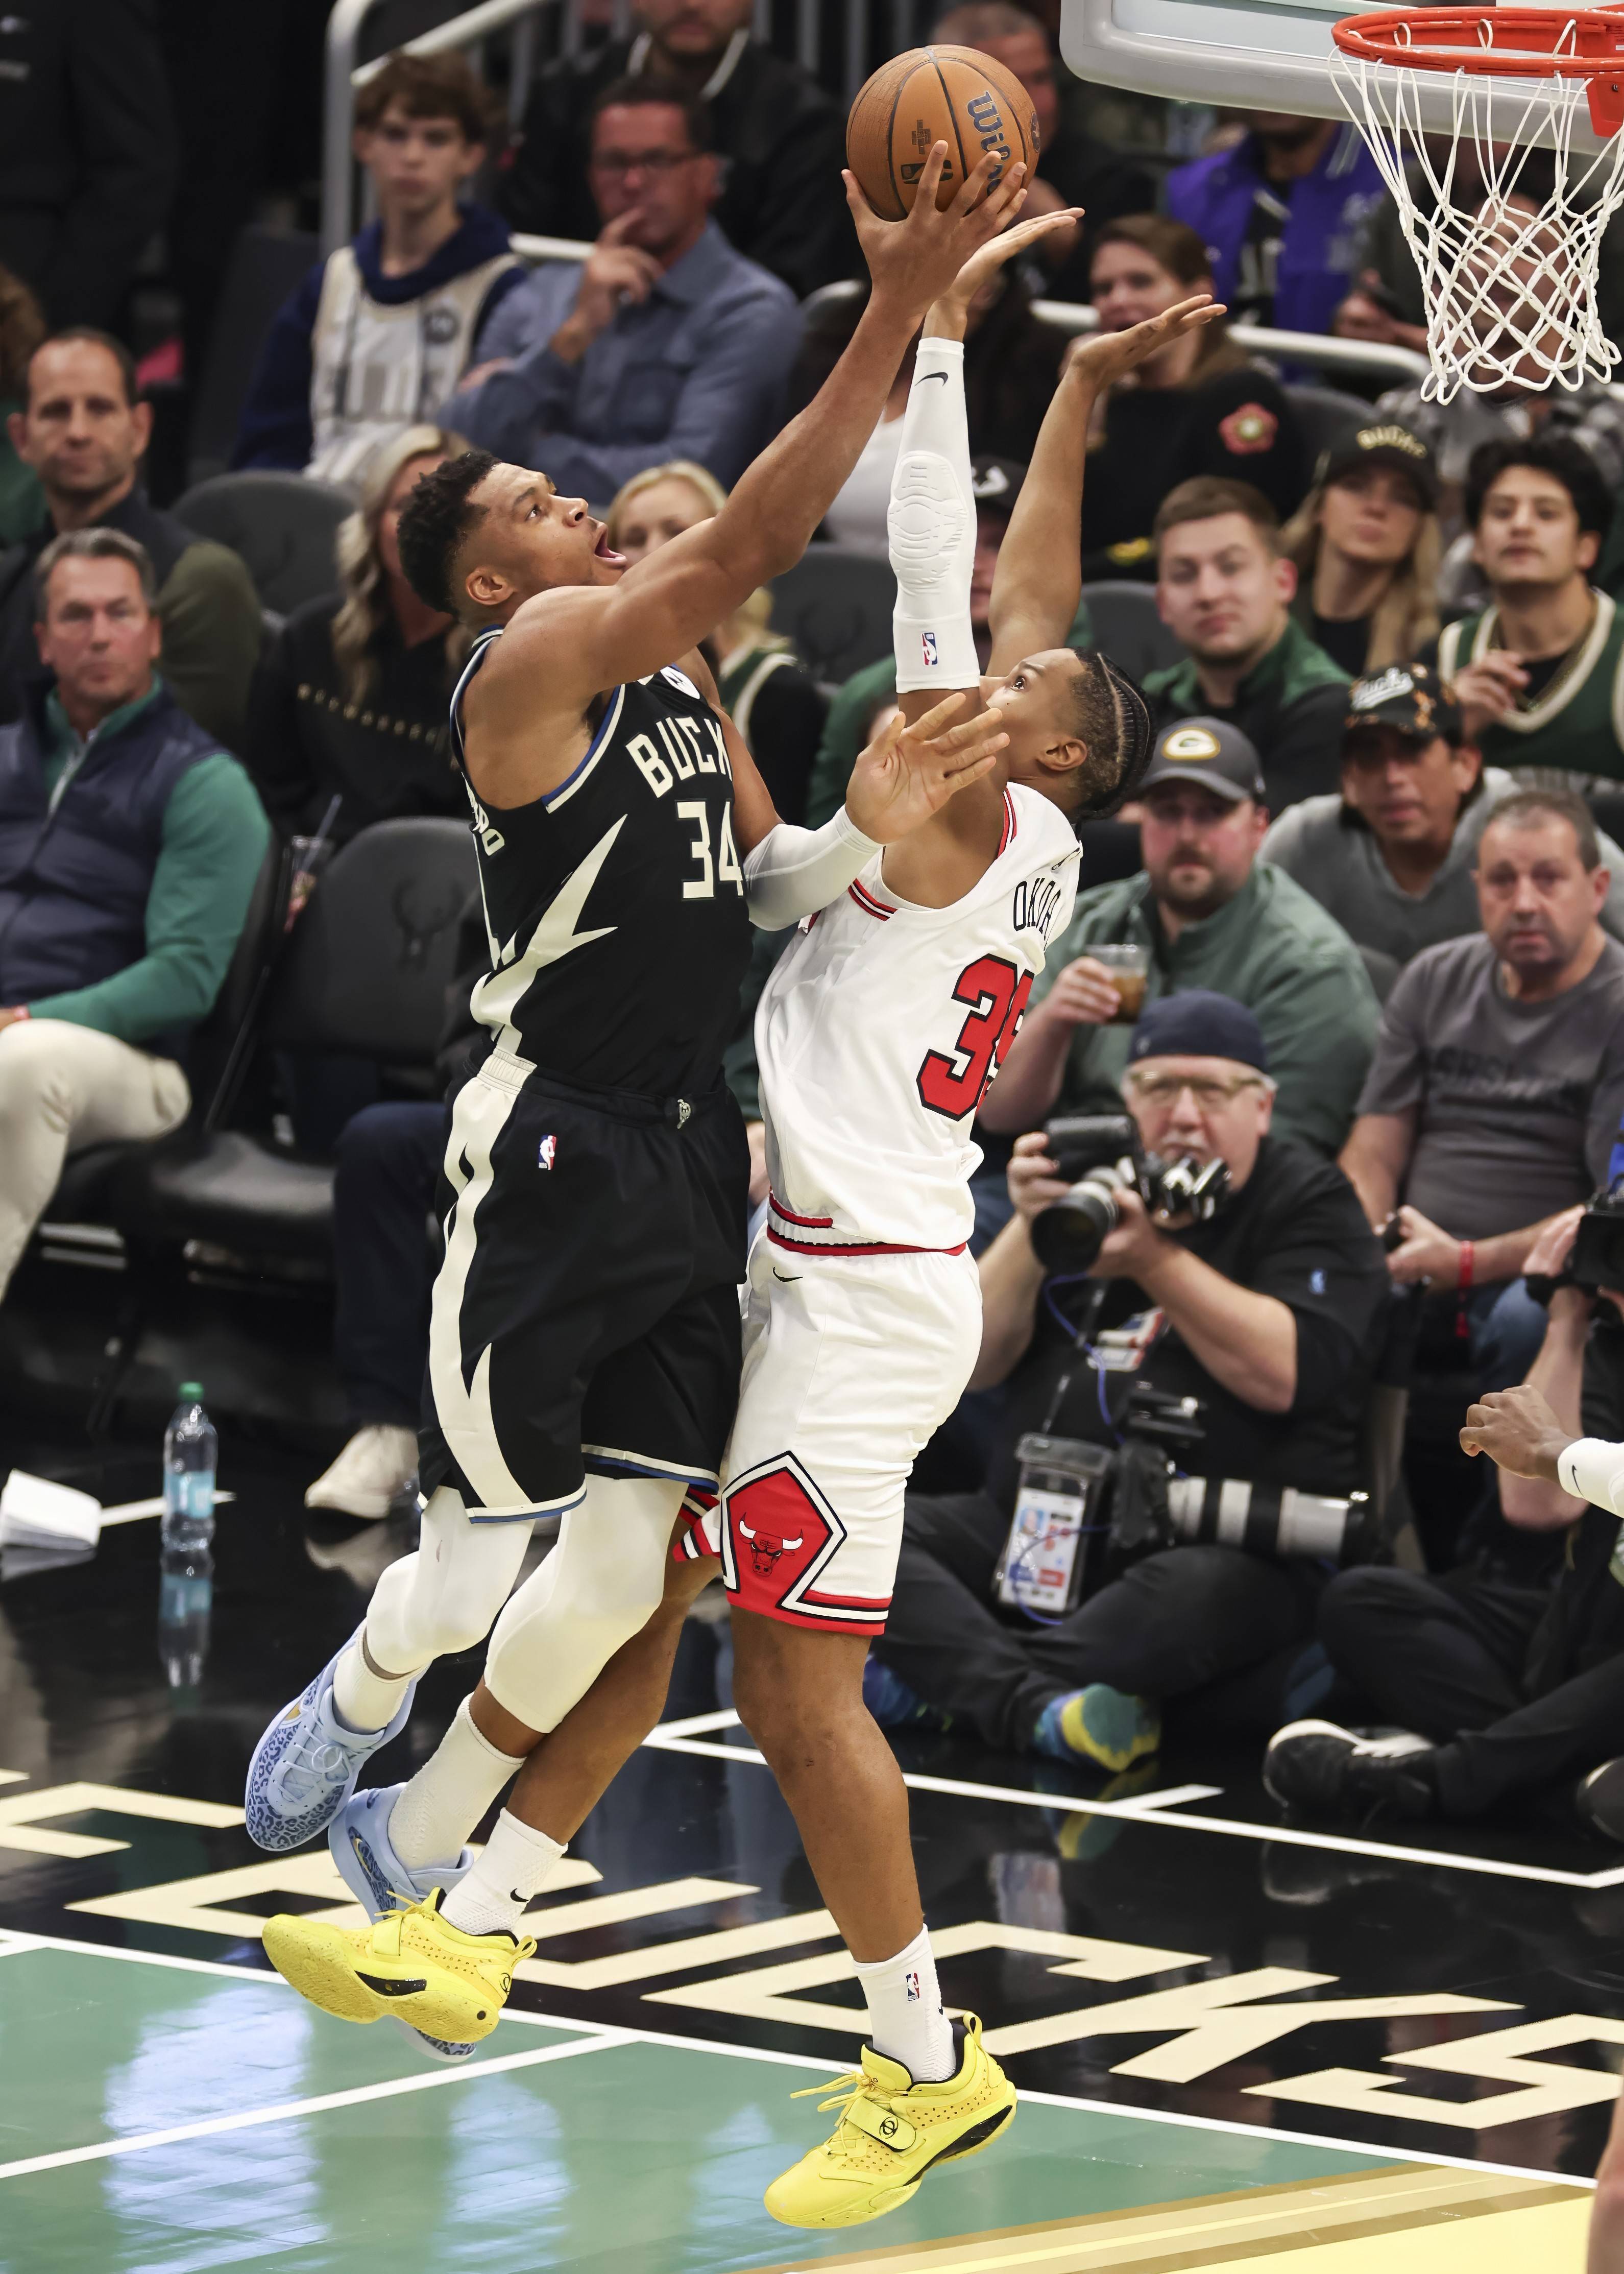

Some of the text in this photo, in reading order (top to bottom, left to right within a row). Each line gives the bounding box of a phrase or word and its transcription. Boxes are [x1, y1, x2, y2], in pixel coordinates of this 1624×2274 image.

[625, 717, 732, 798] BUCK
[676, 801, 744, 899] 34
[1013, 877, 1061, 951] OKOR
